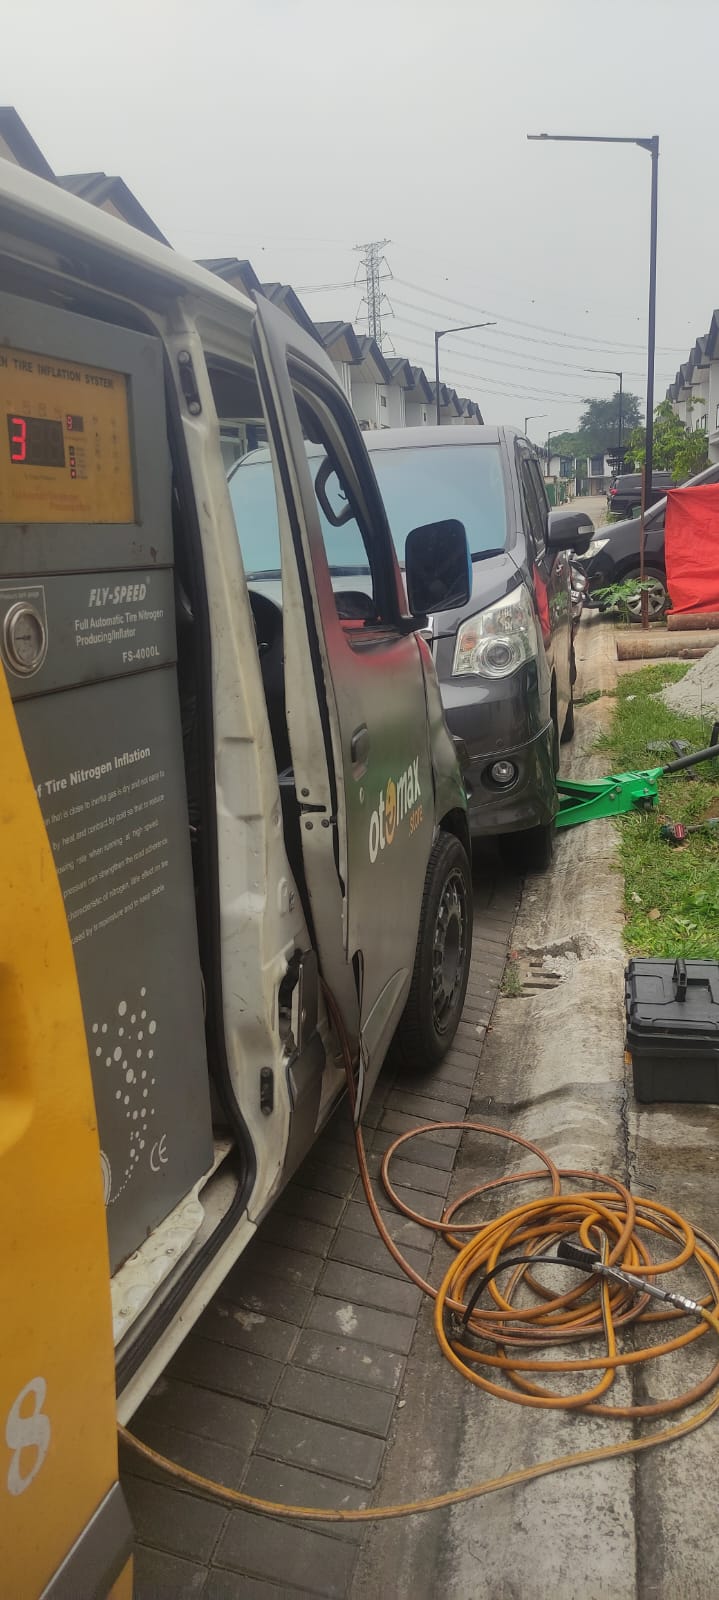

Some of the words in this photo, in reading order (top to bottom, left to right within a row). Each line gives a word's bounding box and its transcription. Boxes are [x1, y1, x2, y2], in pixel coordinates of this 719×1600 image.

[14, 359, 32, 373] TIRE
[38, 364, 80, 381] INFLATION
[85, 375, 113, 388] SYSTEM
[12, 418, 26, 460] 3
[88, 583, 147, 608] FLY-SPEED
[74, 619, 89, 631] Full
[90, 613, 125, 629] Automatic
[125, 612, 138, 624] Tire
[138, 608, 164, 622] Nitrogen
[76, 628, 136, 646] Producing/Inflator
[122, 645, 160, 663] FS-4000L
[45, 779, 67, 795] Tire
[69, 762, 112, 786] Nitrogen
[114, 747, 151, 768] Inflation
[369, 755, 421, 863] otomax
[409, 804, 423, 834] store
[151, 1134, 168, 1172] CE
[6, 1376, 51, 1496] 8
